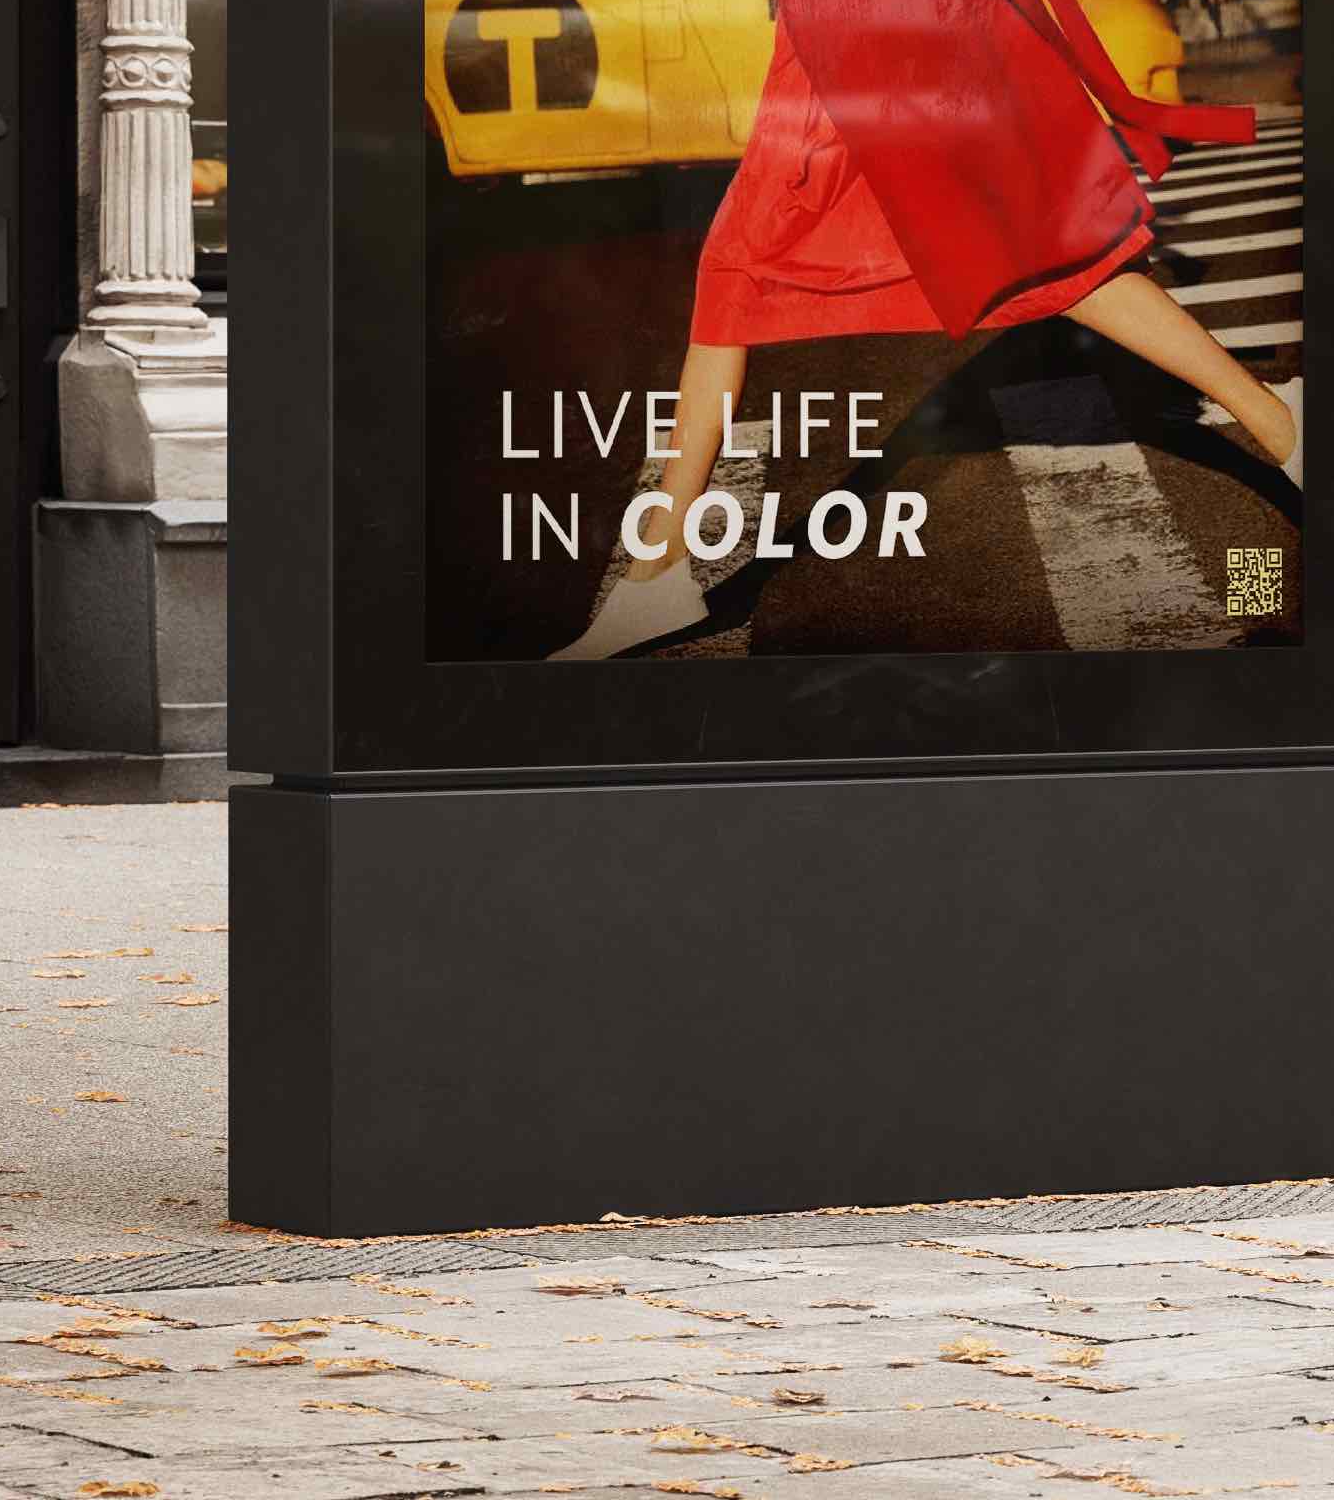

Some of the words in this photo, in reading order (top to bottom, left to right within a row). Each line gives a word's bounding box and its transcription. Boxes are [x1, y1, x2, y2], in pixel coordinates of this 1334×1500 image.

[503, 391, 683, 458] LIVE
[722, 391, 884, 458] LIFE
[503, 493, 579, 561] IN
[621, 490, 928, 560] COLOR
